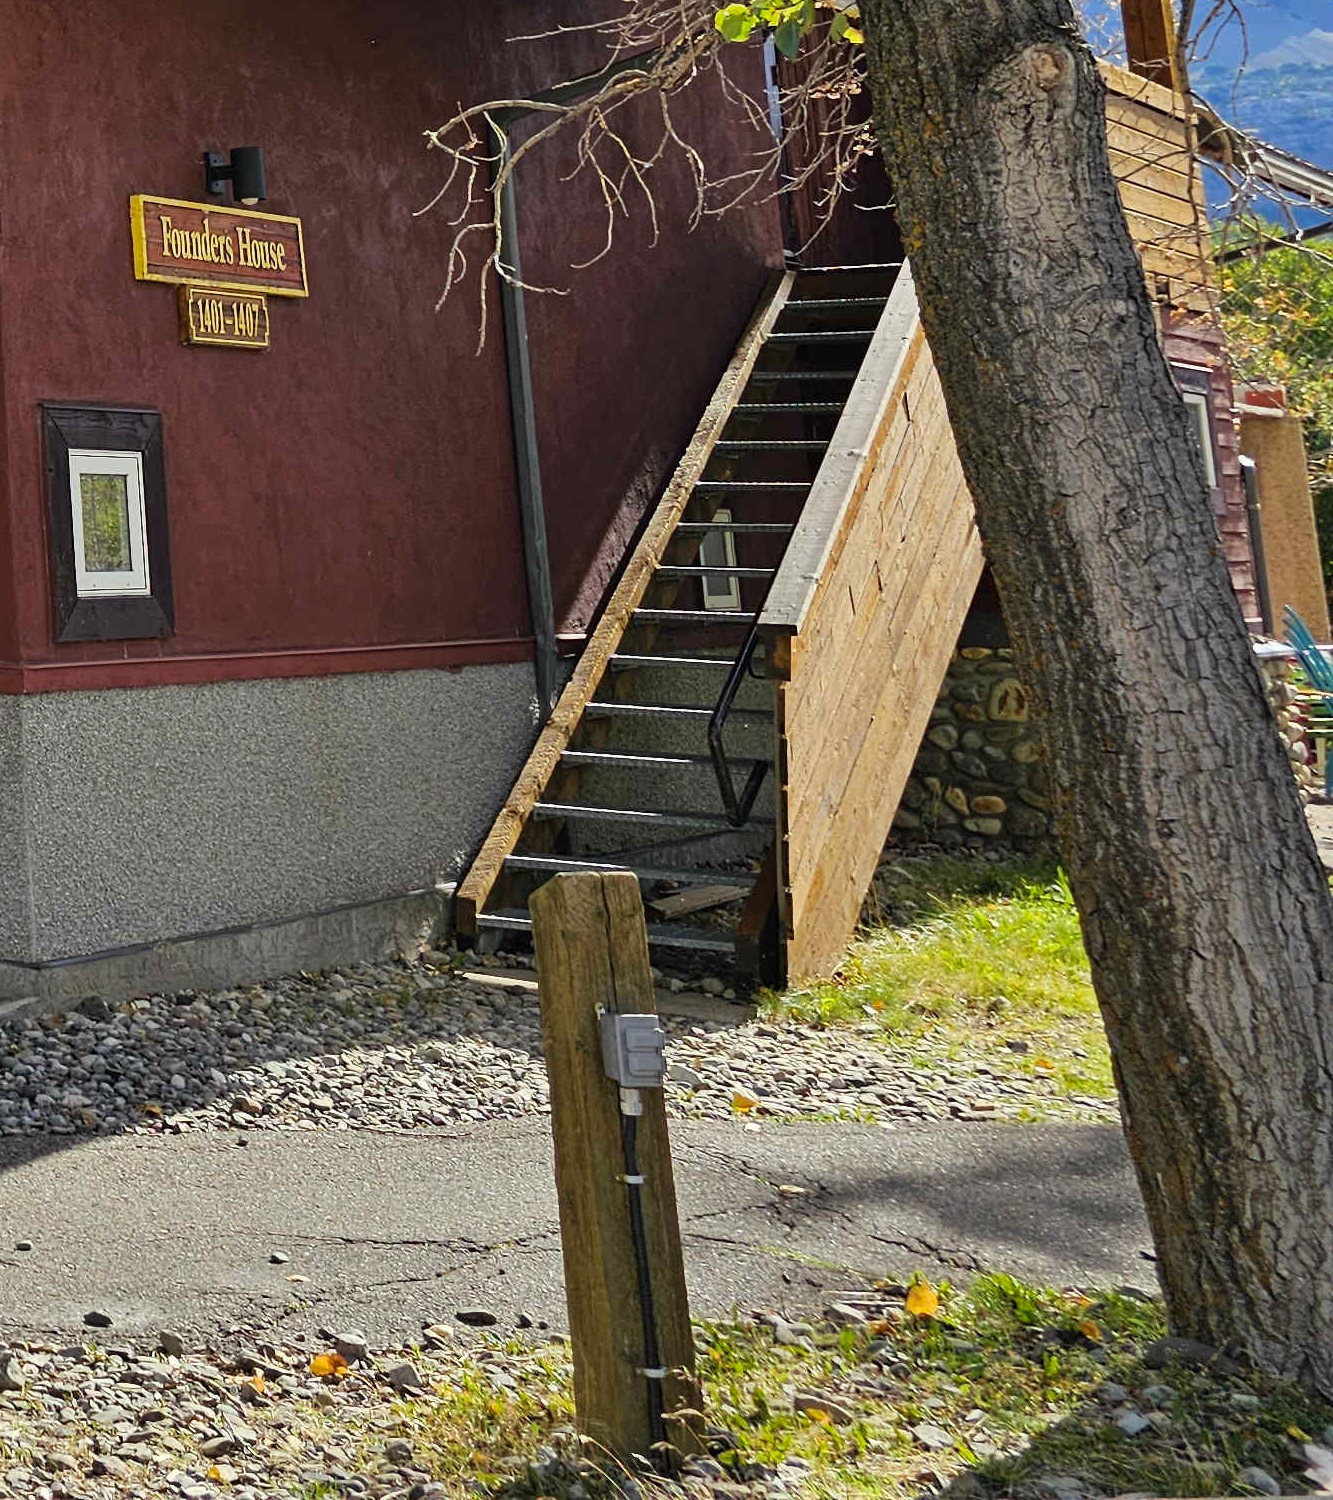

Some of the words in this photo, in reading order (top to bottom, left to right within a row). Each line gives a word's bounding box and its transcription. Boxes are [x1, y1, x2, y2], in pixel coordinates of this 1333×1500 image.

[159, 215, 234, 265] Founders
[236, 227, 287, 271] House
[197, 299, 259, 337] 1401-1407
